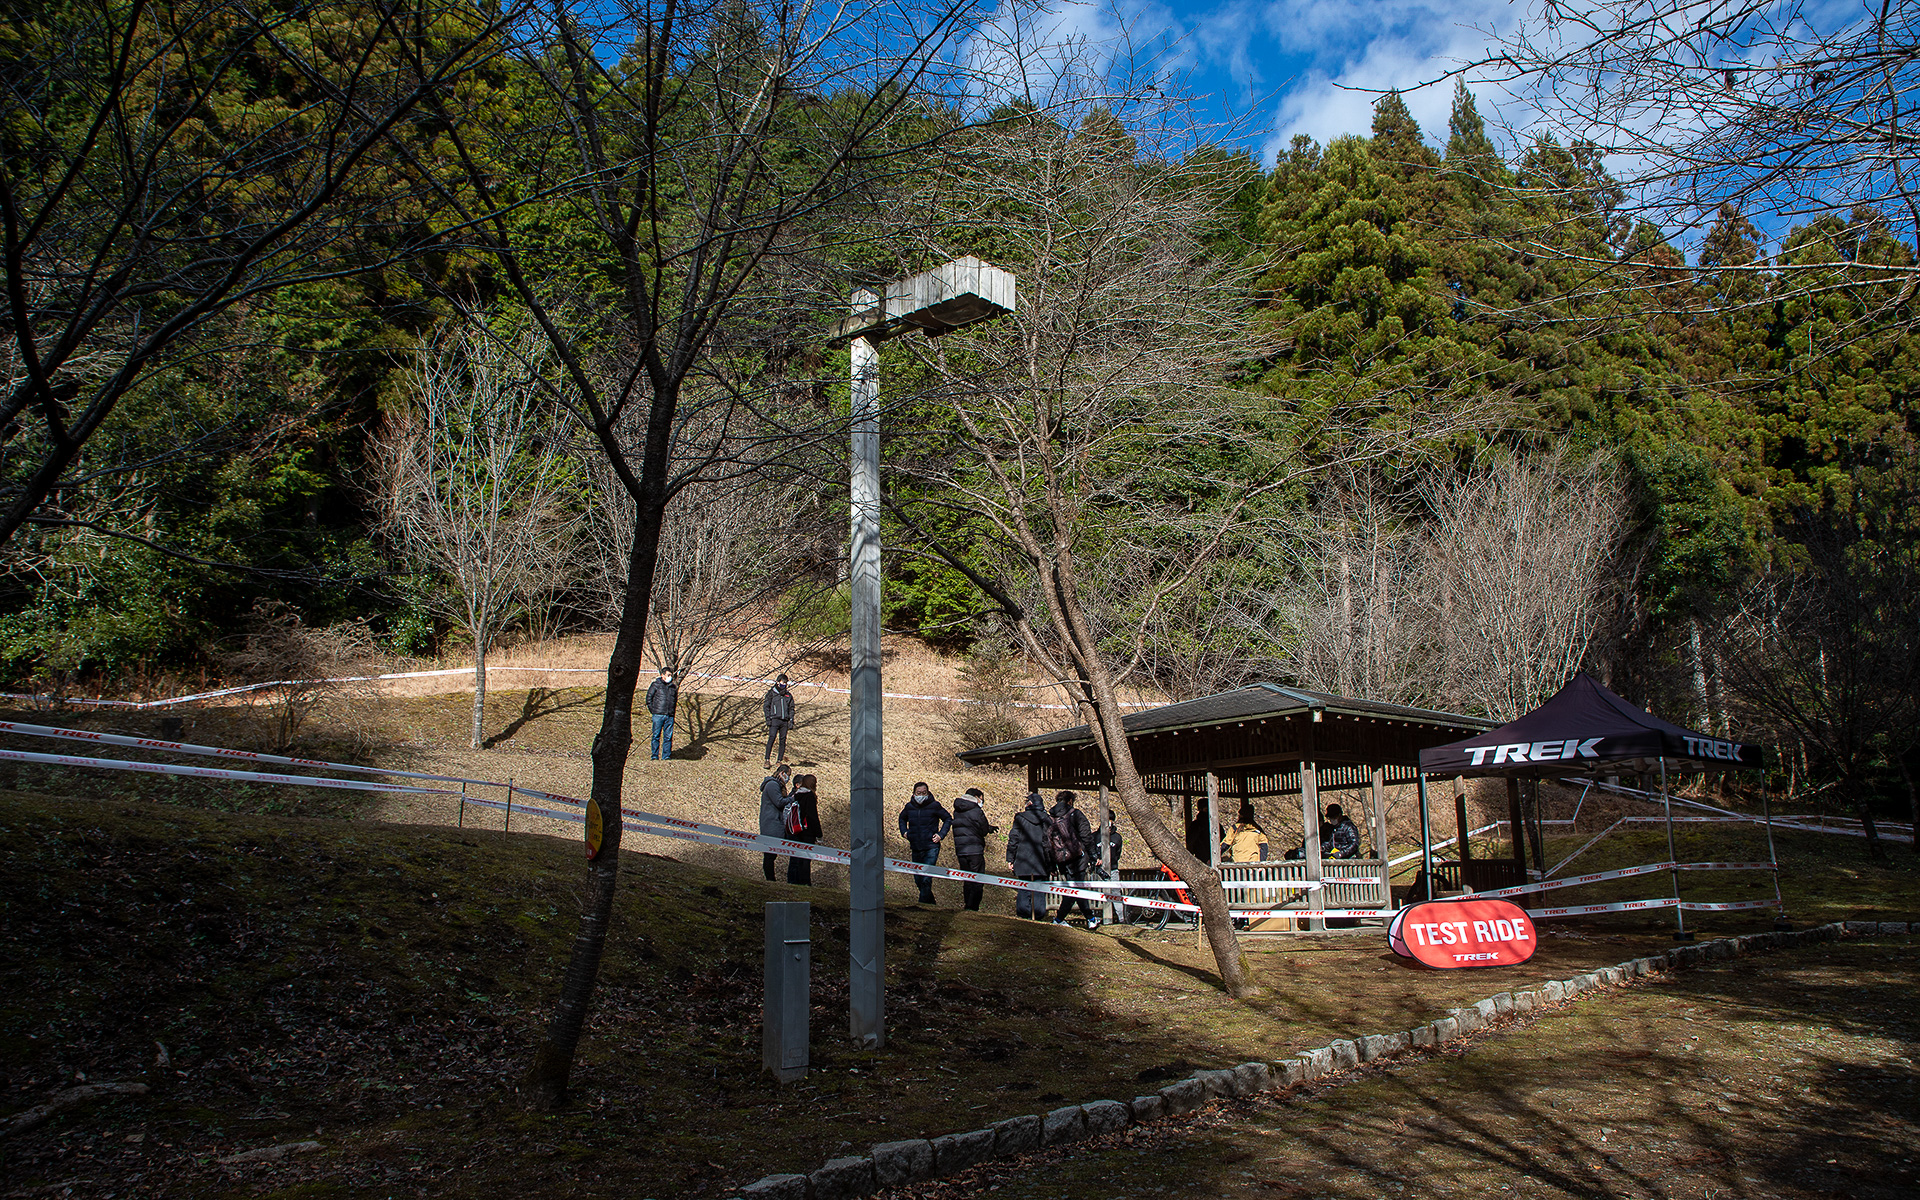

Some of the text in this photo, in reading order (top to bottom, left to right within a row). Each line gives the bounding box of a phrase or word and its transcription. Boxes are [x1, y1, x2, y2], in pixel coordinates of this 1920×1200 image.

[51, 728, 103, 740] TREK
[136, 738, 183, 750] TREK
[1682, 735, 1743, 762] TREK
[215, 748, 259, 759] TREK
[1463, 736, 1605, 766] TREK
[544, 792, 582, 805] TREK
[665, 817, 701, 830] TREK
[723, 828, 758, 841] TREK
[780, 839, 815, 852] TREK
[836, 850, 850, 859] TR
[891, 859, 925, 871] TREK
[945, 868, 978, 880] TREK
[1617, 867, 1641, 876] TREK
[997, 877, 1030, 888] TREK
[1578, 873, 1603, 882] TREK
[1538, 879, 1564, 889] TREK
[1049, 885, 1080, 896] TREK
[1497, 887, 1523, 896] TREK
[1099, 893, 1129, 903] TREK
[1148, 900, 1178, 910] TREK
[1583, 904, 1609, 913] TREK
[1623, 901, 1648, 909] TREK
[1543, 908, 1569, 916] TREK
[1410, 918, 1530, 946] TEST RIDE
[1452, 952, 1500, 962] TREK
